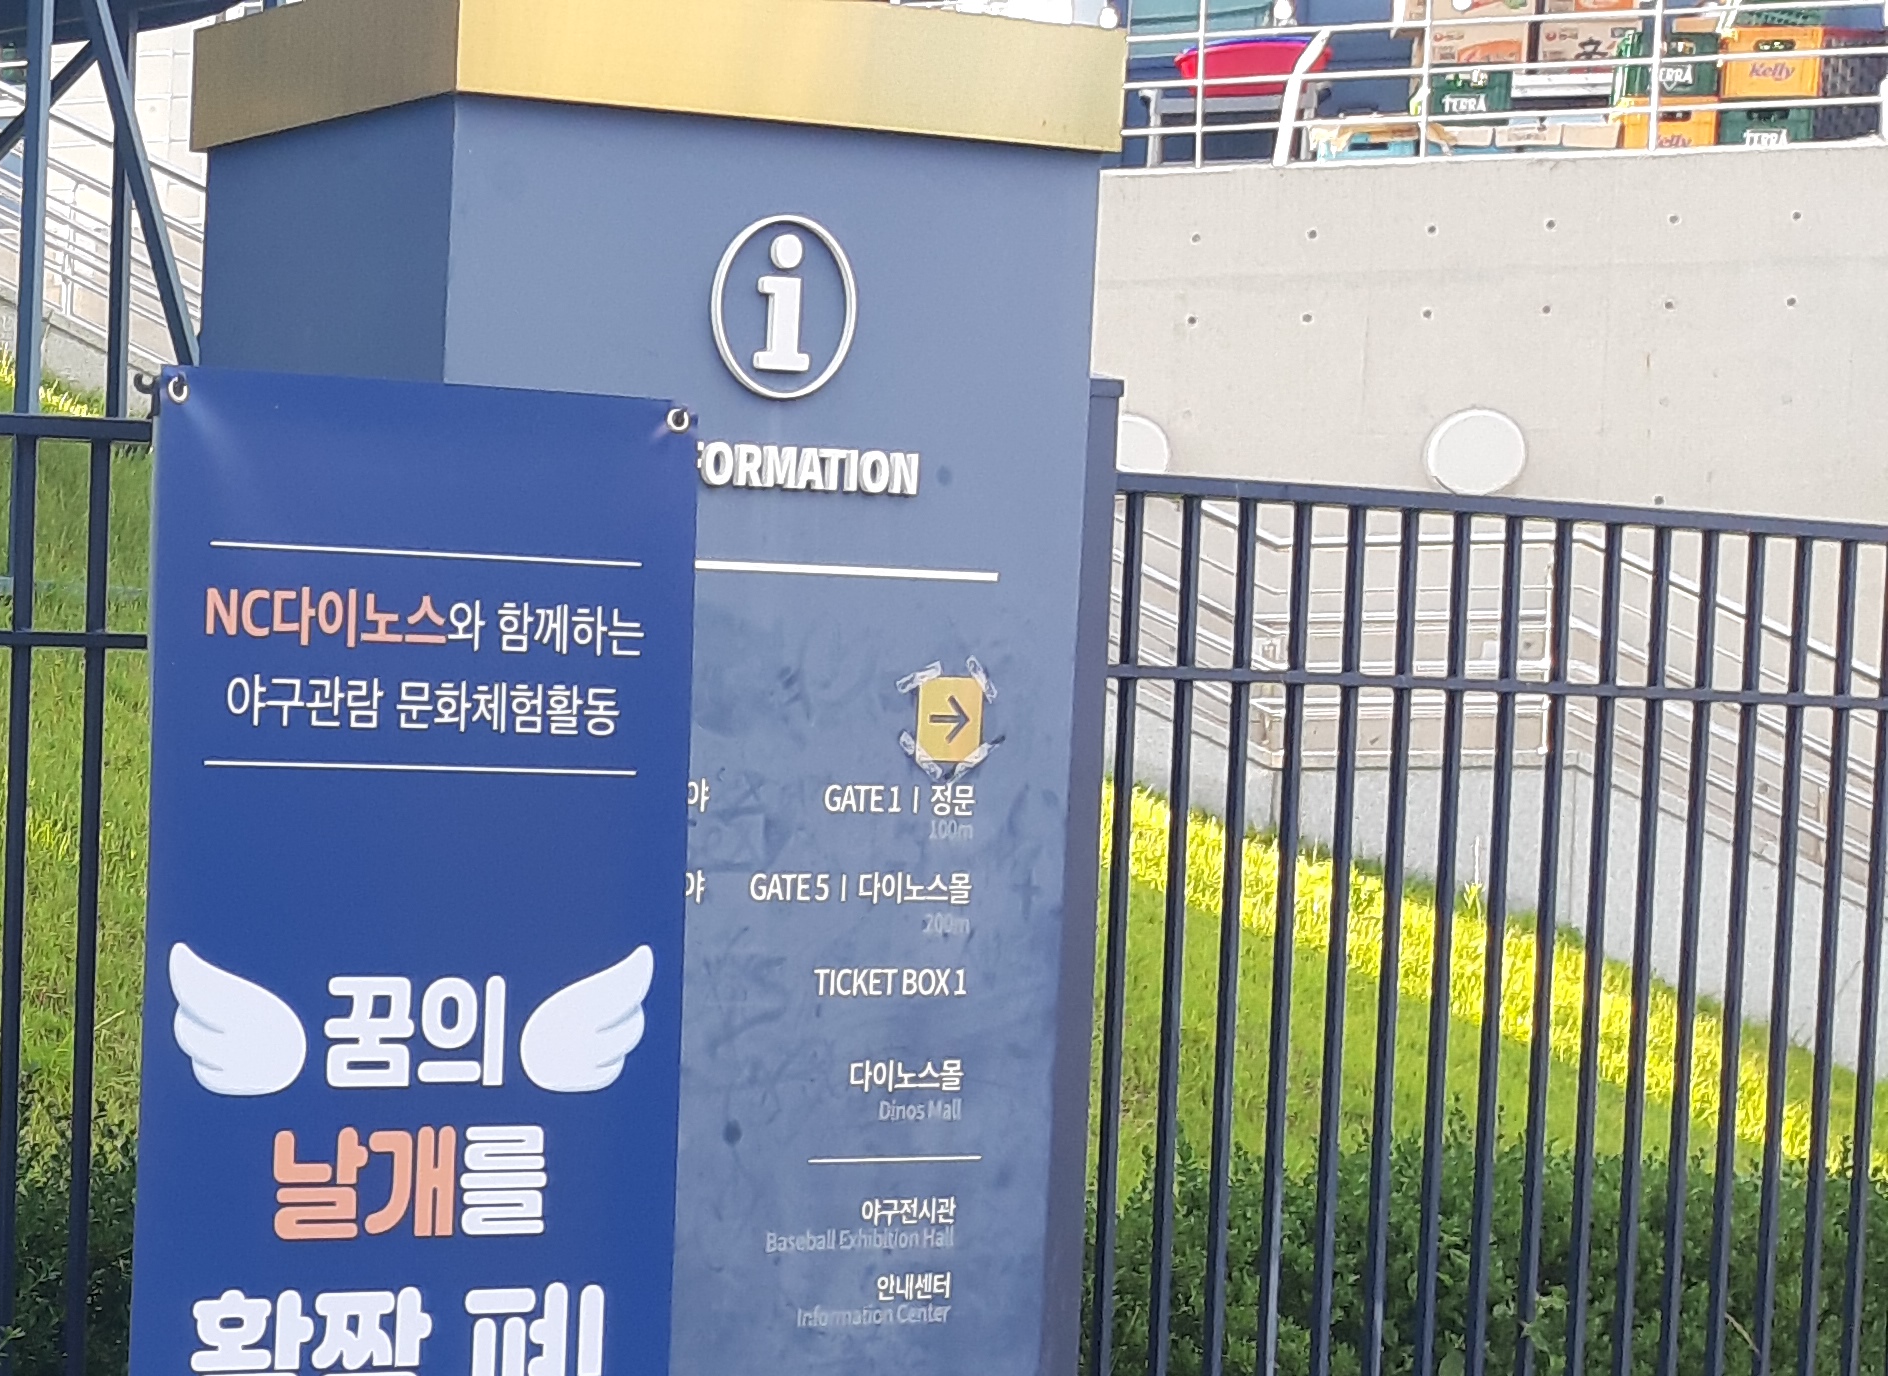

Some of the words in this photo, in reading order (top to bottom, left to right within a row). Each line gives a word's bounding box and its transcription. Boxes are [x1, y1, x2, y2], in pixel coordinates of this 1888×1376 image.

[1649, 64, 1693, 84] ERRA
[1750, 62, 1796, 81] Kelly
[697, 440, 920, 496] ORMATION
[204, 585, 486, 653] NC다이노스와
[496, 600, 646, 657] 함께하는
[226, 674, 385, 728] 야구관람
[395, 679, 621, 737] 문화체험활동
[824, 784, 884, 813] GATE
[889, 785, 901, 812] 1
[930, 783, 977, 817] 정문
[928, 819, 974, 841] 100m
[750, 873, 812, 901] GATE
[814, 873, 830, 901] 5
[857, 871, 973, 904] 다이노스몰
[922, 912, 971, 934] 200m
[814, 968, 898, 997] TICKET
[901, 968, 951, 997] BOX
[954, 969, 967, 995] 1
[323, 974, 507, 1088] 꿈의
[849, 1059, 965, 1092] 다이노스몰
[878, 1100, 925, 1122] Dinos
[927, 1098, 963, 1121] Mall
[272, 1124, 549, 1243] 날개를
[861, 1196, 957, 1226] 야구전시관
[765, 1229, 836, 1253] Baseball
[923, 1227, 955, 1248] Hall
[877, 1271, 952, 1301] 안내센터
[796, 1305, 894, 1328] Information
[896, 1303, 952, 1324] Center
